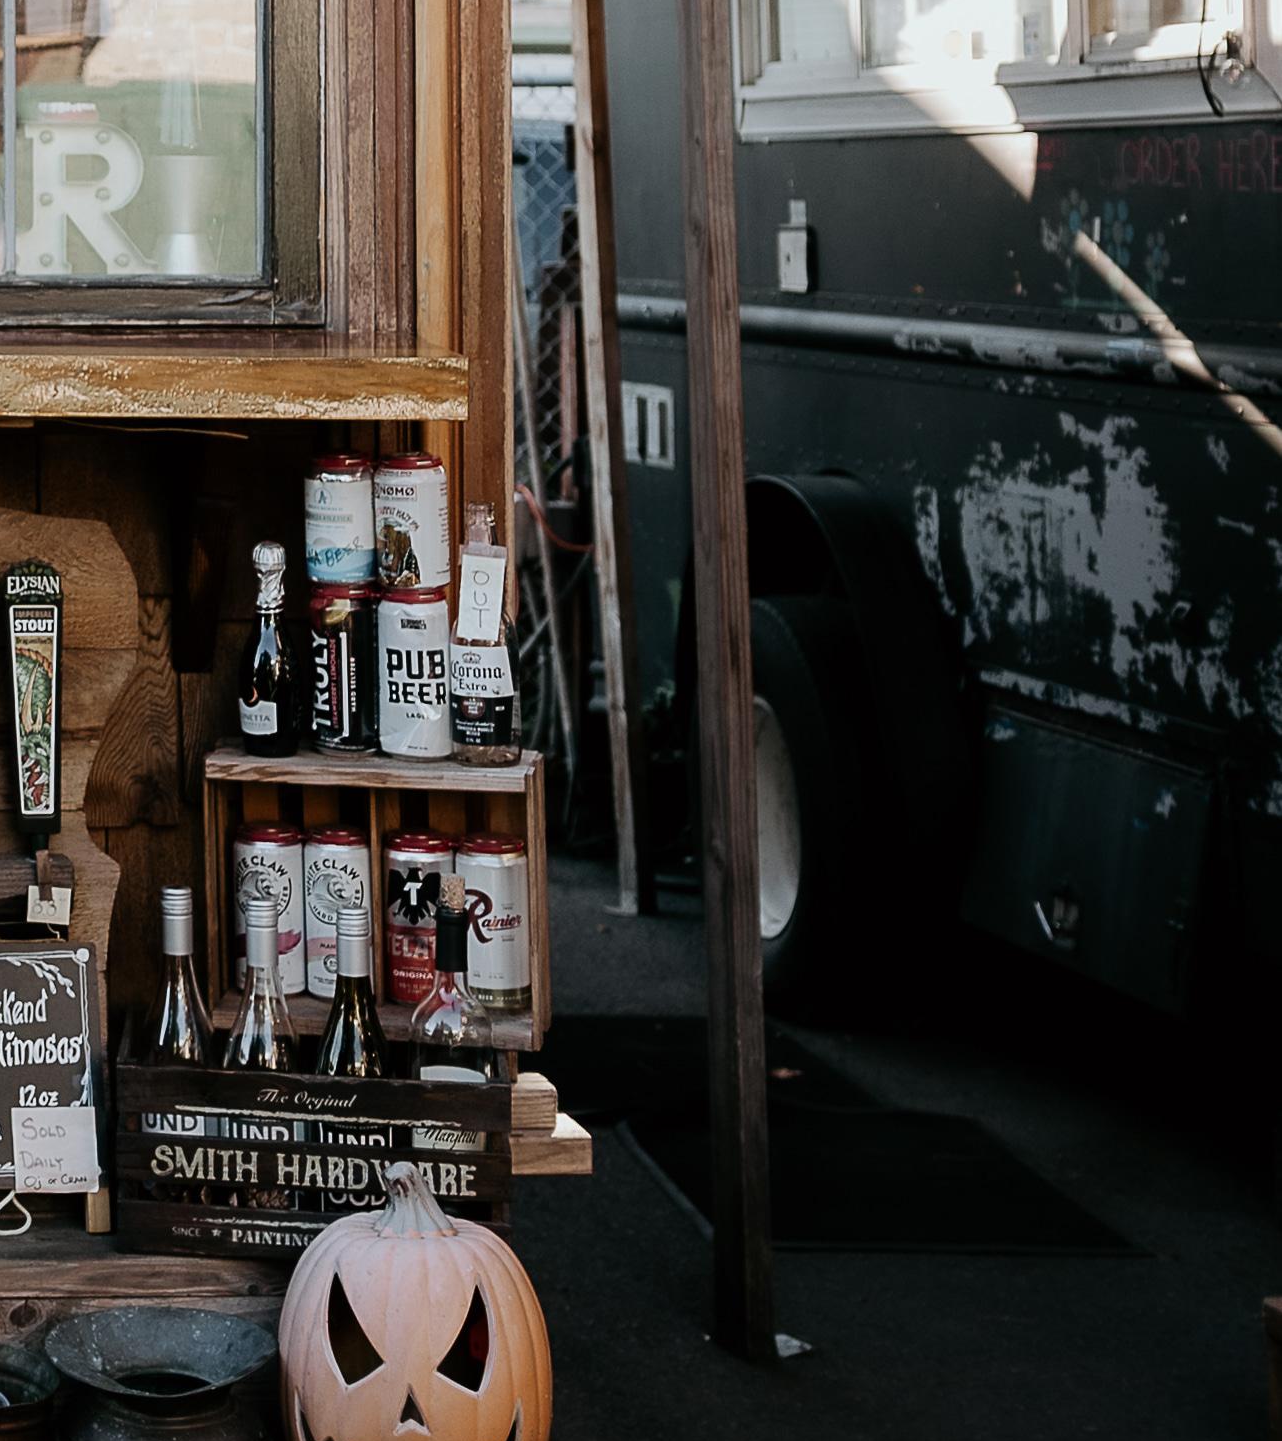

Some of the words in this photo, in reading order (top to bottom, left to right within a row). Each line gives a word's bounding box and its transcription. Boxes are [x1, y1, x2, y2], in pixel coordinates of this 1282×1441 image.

[1118, 134, 1202, 189] ORDER
[7, 576, 60, 594] ELYSIAN
[14, 619, 54, 632] STOUT
[386, 649, 446, 680] PUB
[451, 660, 502, 679] Corona
[311, 629, 331, 730] TRULY
[388, 681, 447, 705] BEER
[250, 855, 288, 877] CLAW
[322, 858, 360, 880] CLAW
[465, 888, 522, 944] Rainier
[393, 969, 433, 979] ORIGINA
[257, 1088, 288, 1104] The
[21, 1117, 66, 1140] SOLD
[19, 1150, 64, 1171] DAILY
[150, 1144, 259, 1184] SMITH
[172, 1226, 202, 1237] SINCE
